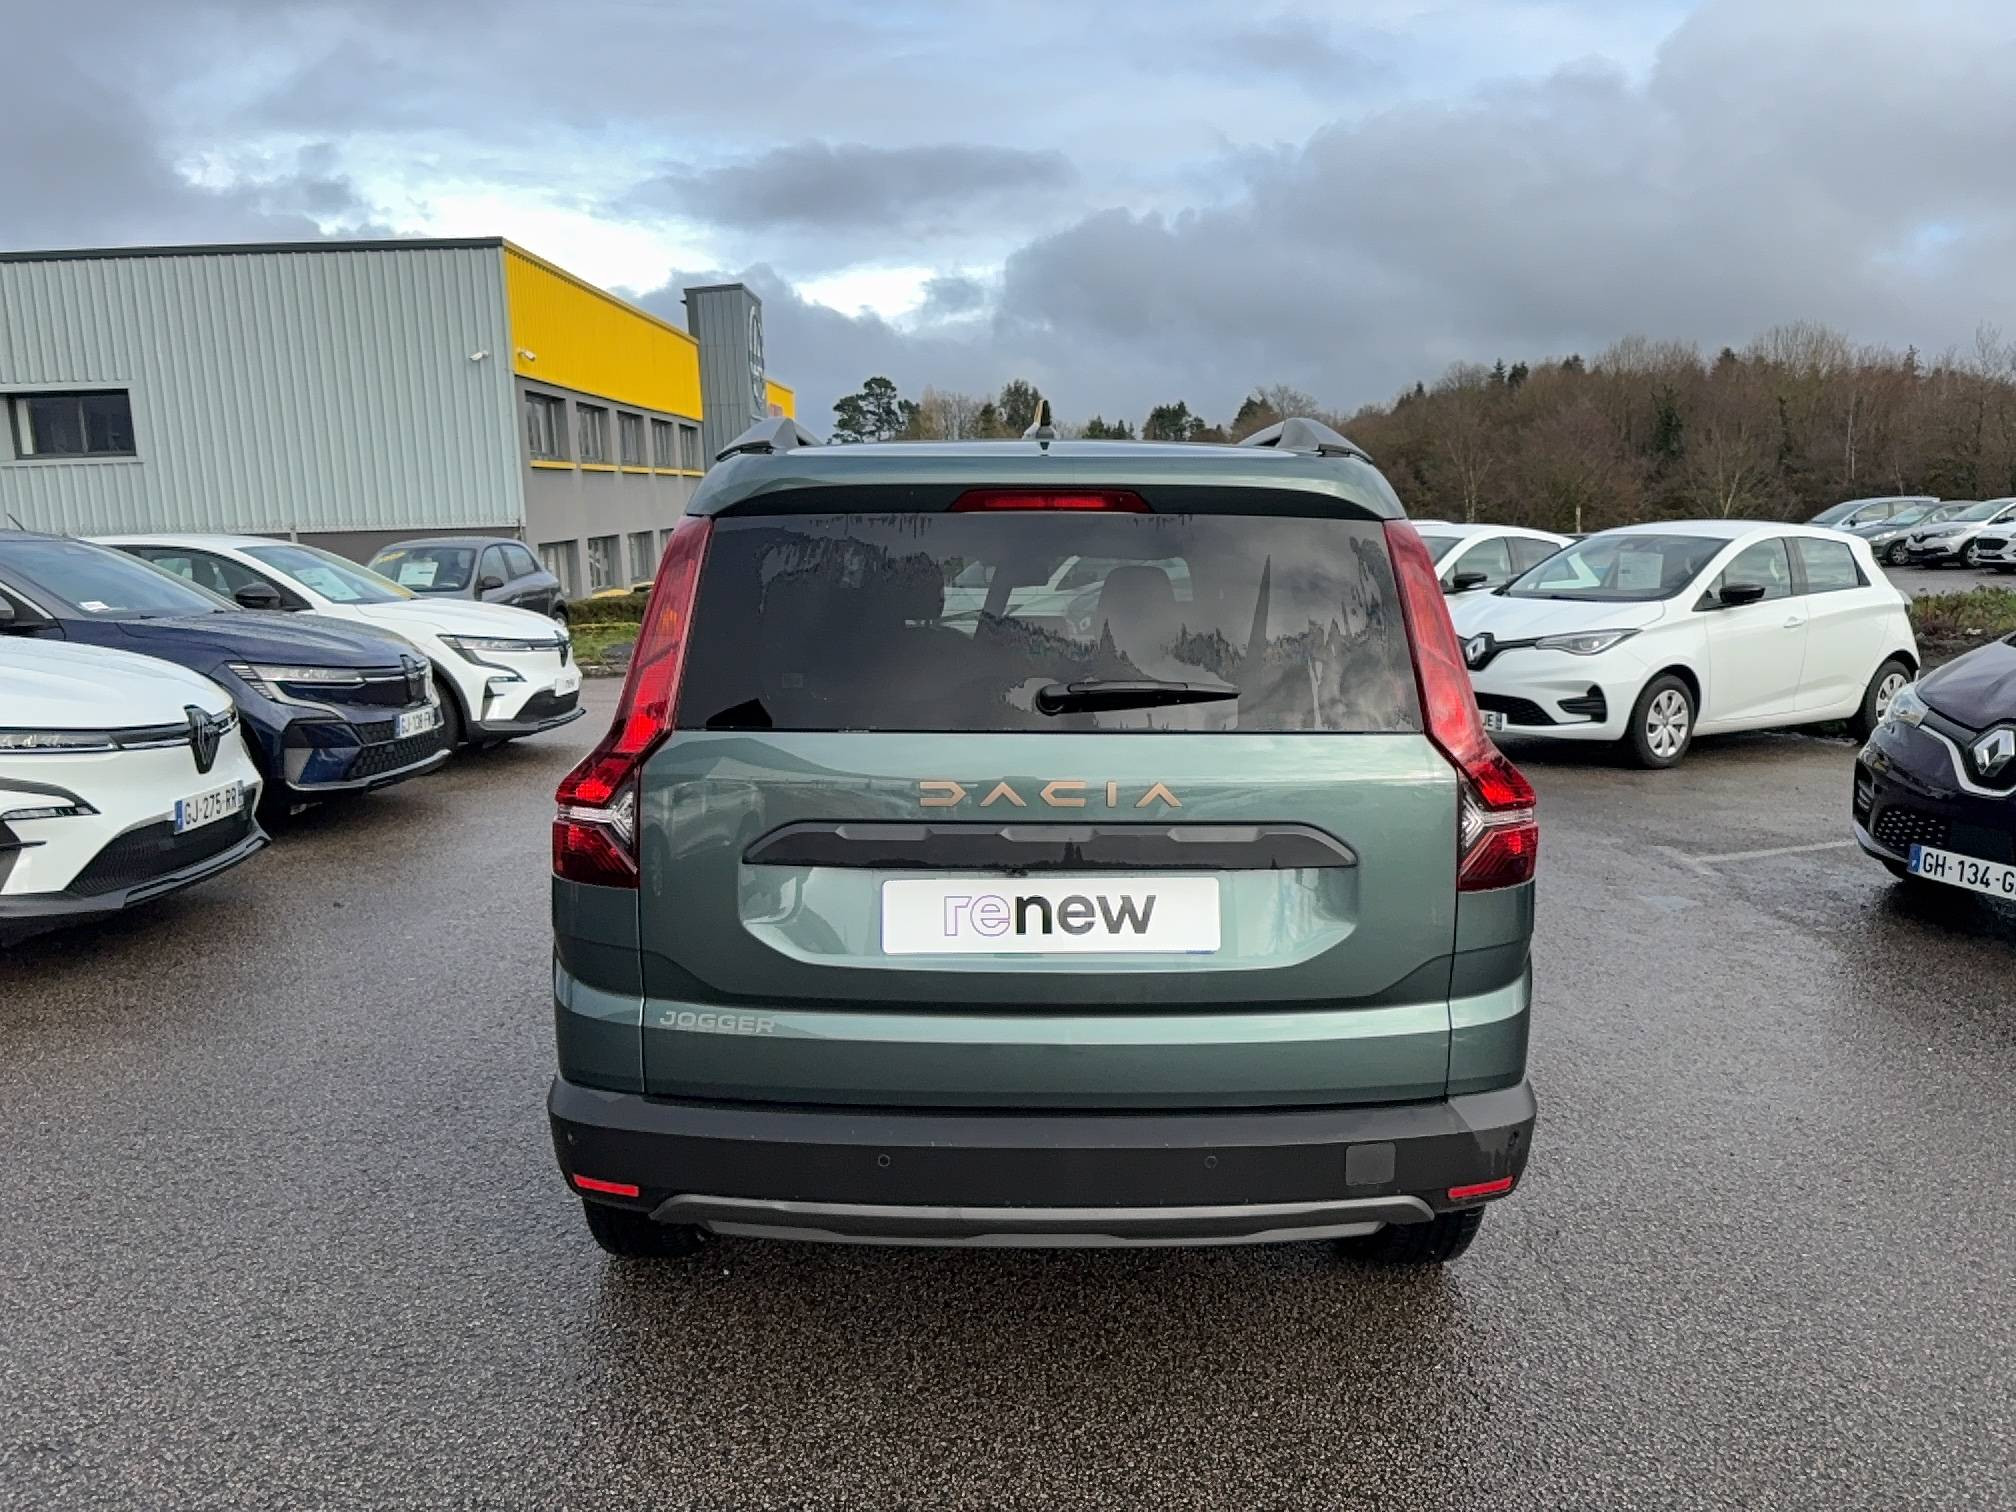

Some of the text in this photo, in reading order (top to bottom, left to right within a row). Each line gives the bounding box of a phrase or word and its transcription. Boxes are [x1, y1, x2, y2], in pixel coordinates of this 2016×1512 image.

[918, 780, 1182, 808] DACIA
[1923, 852, 2016, 894] GH-134-G
[943, 893, 1157, 938] renew
[659, 1010, 776, 1033] JOGGER
